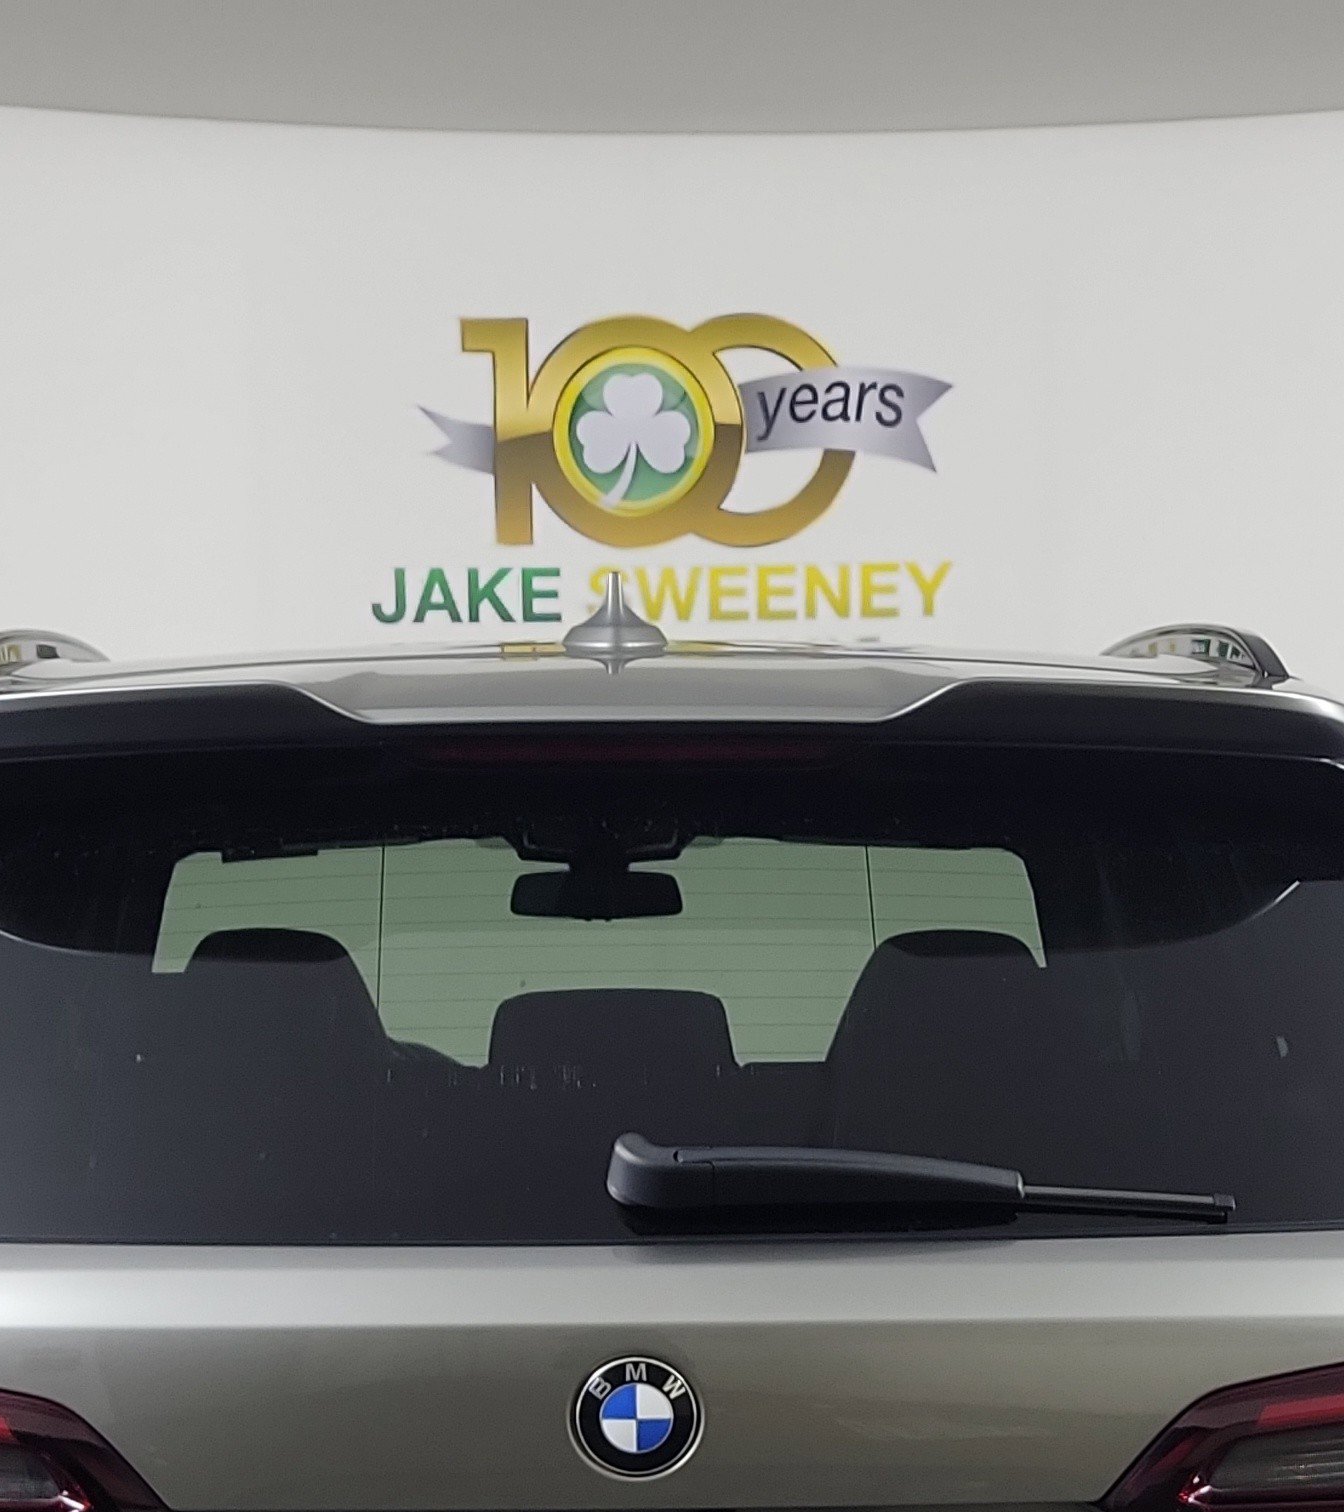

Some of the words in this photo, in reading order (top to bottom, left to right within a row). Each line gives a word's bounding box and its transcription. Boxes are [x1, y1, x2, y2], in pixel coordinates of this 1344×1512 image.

[756, 379, 904, 440] years
[371, 567, 562, 623] JAKE
[588, 1363, 686, 1400] BMW
